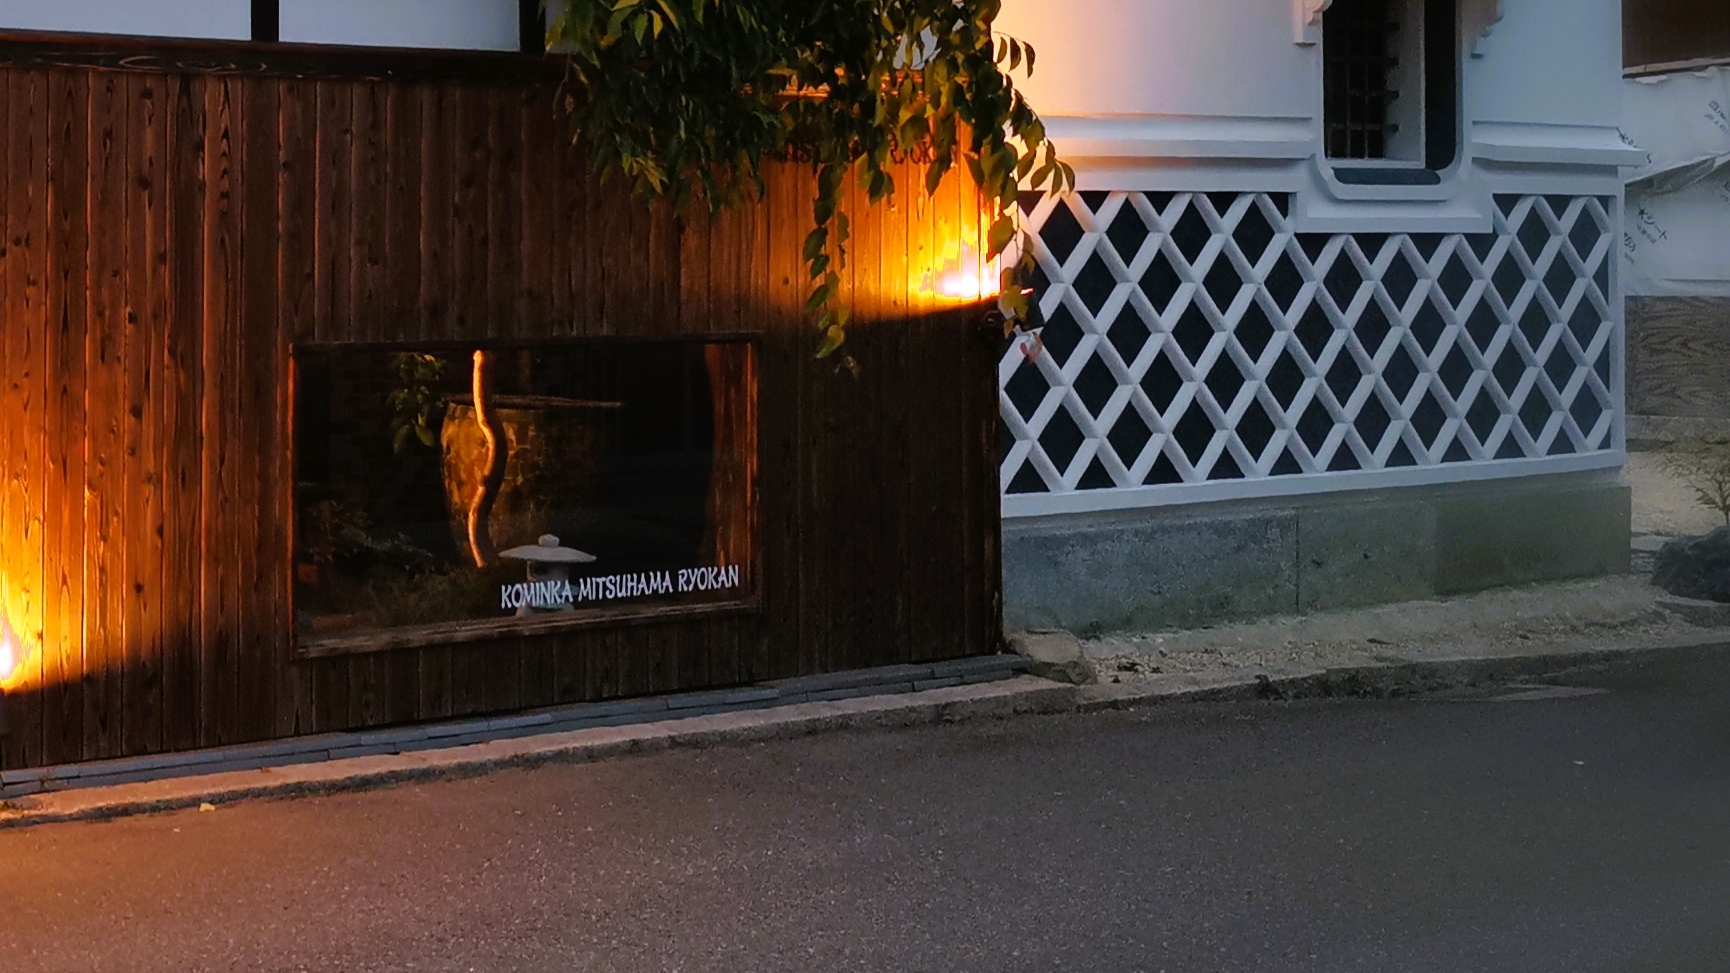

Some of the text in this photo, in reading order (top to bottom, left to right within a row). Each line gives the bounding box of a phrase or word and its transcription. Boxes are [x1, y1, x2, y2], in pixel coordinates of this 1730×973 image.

[501, 564, 739, 609] KOMINKA MITSUHAMA RYOKAN
